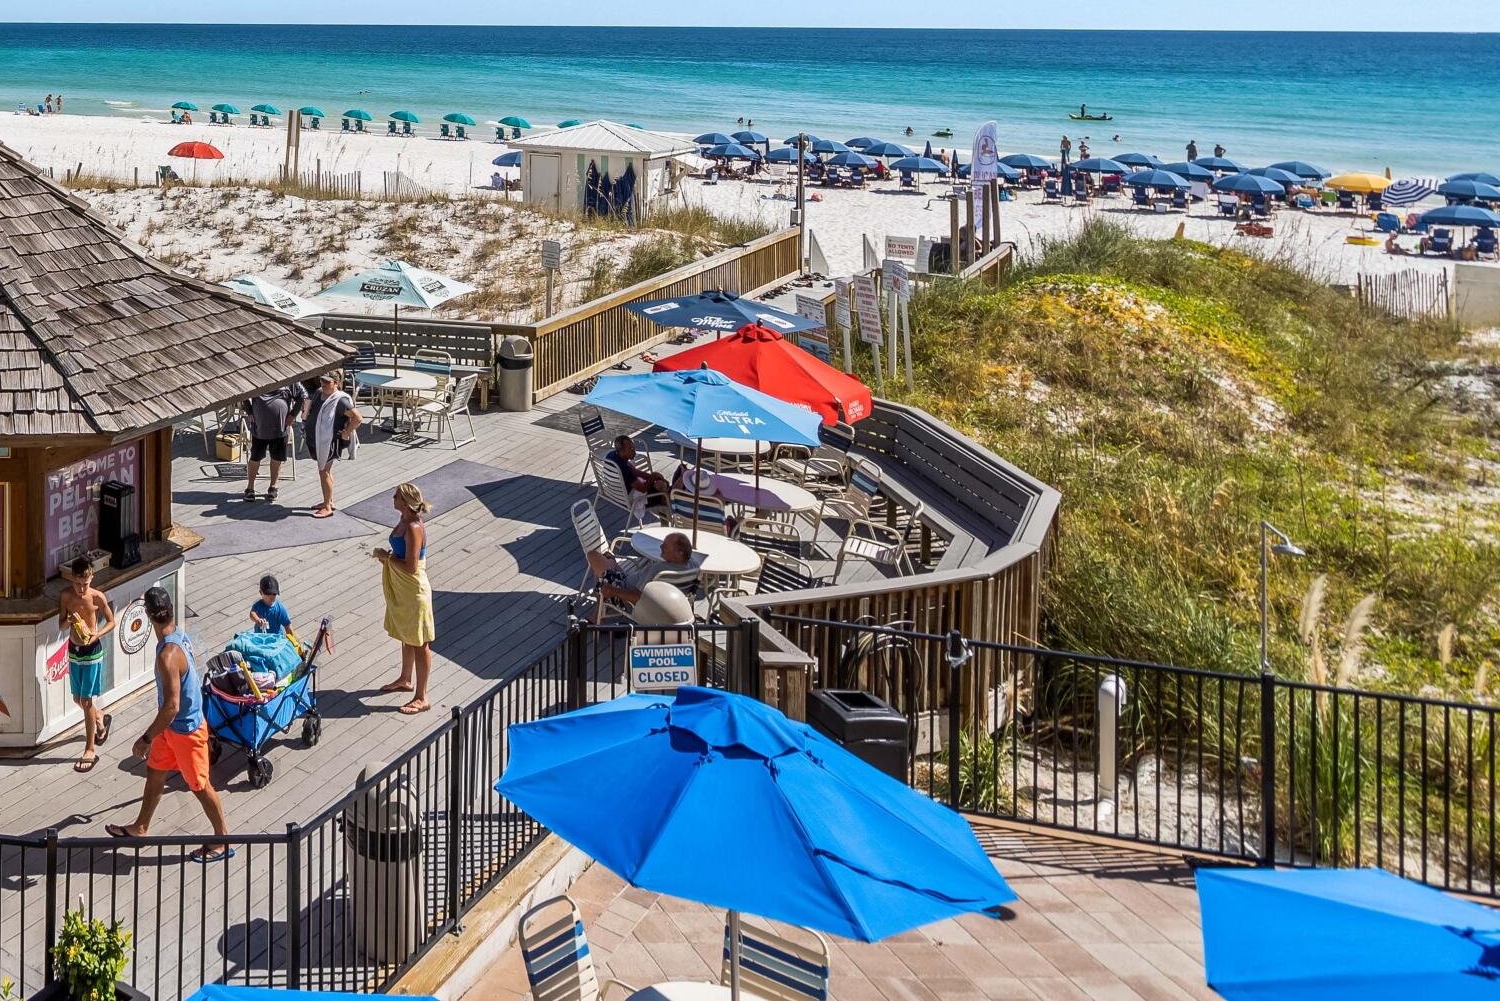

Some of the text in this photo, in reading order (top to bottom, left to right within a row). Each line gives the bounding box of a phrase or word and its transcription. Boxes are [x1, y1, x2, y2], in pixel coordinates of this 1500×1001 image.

[888, 248, 915, 256] ALLOWED
[364, 284, 400, 293] CRUZAN
[712, 414, 767, 425] ULTRA
[48, 446, 136, 491] WELCOME TO
[633, 647, 692, 658] SWIMMING
[648, 657, 677, 667] POOL
[638, 671, 690, 683] CLOSED
